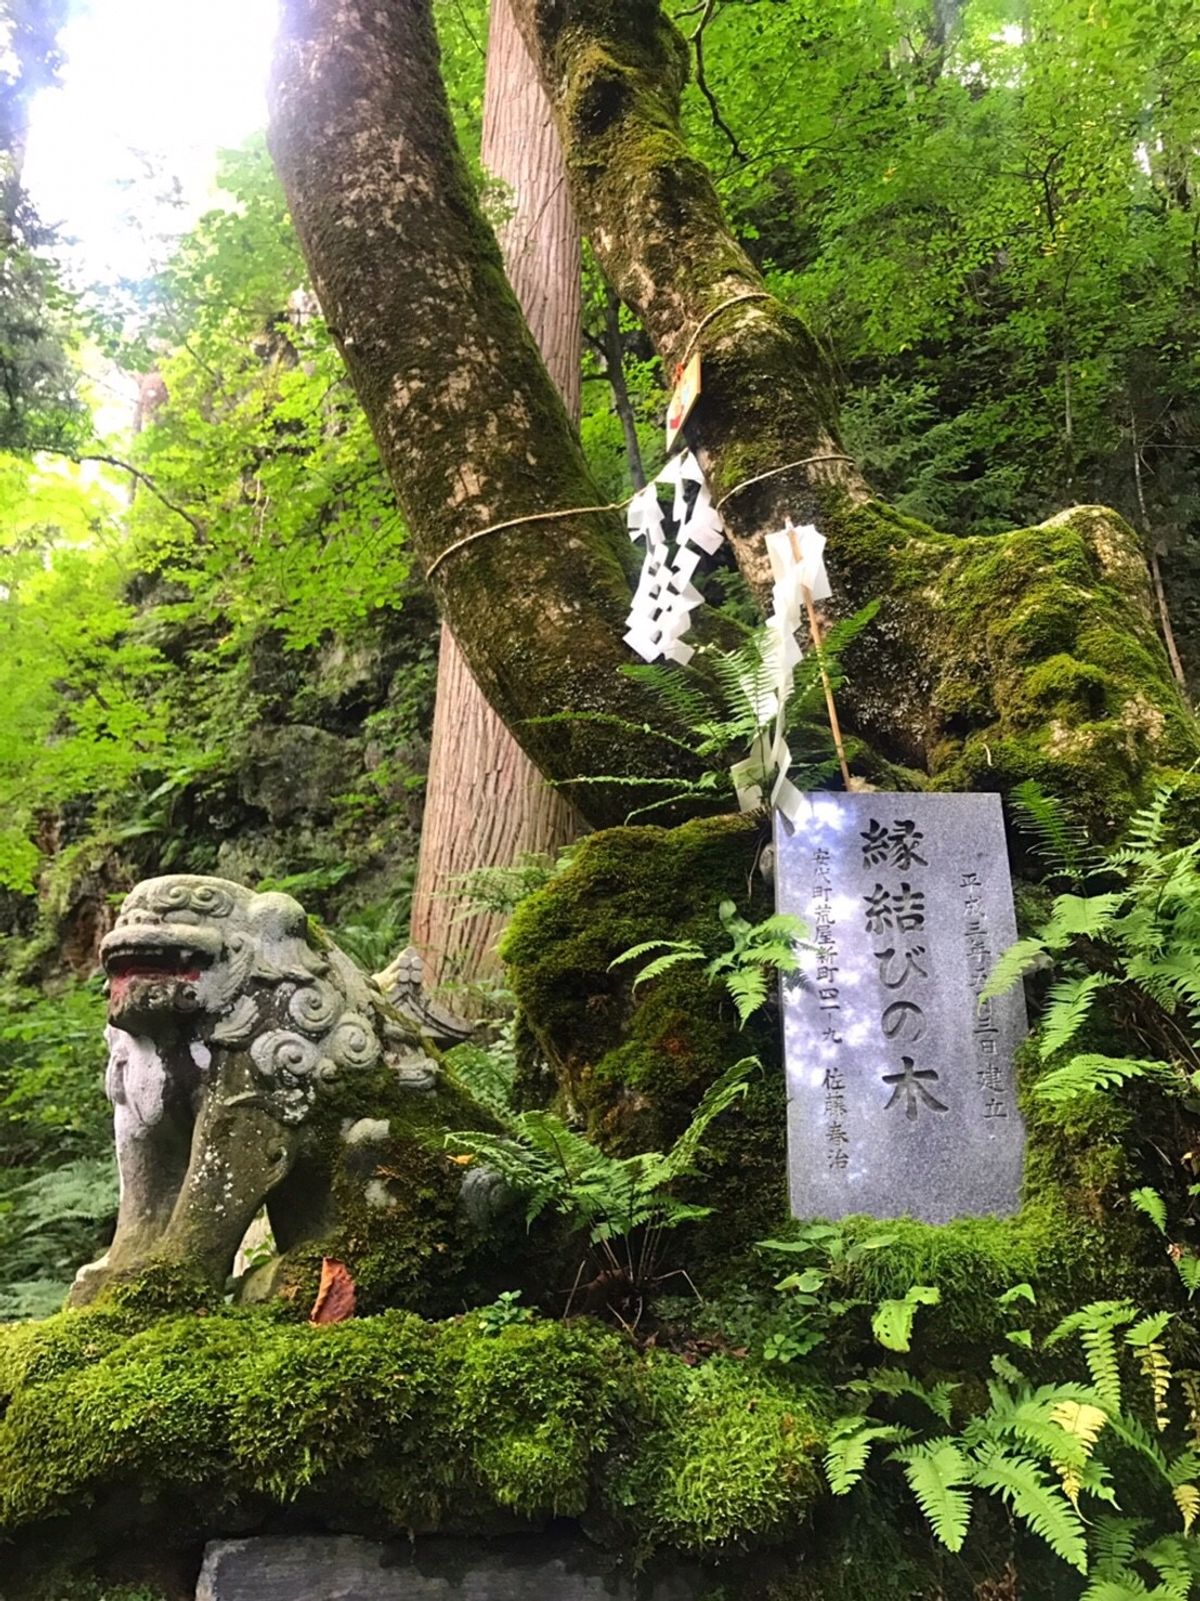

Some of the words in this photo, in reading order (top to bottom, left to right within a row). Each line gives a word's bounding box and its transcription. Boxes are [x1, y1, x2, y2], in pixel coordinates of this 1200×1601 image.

[859, 818, 949, 1122] 縁結びの木
[821, 1067, 850, 1169] 佐藤春治
